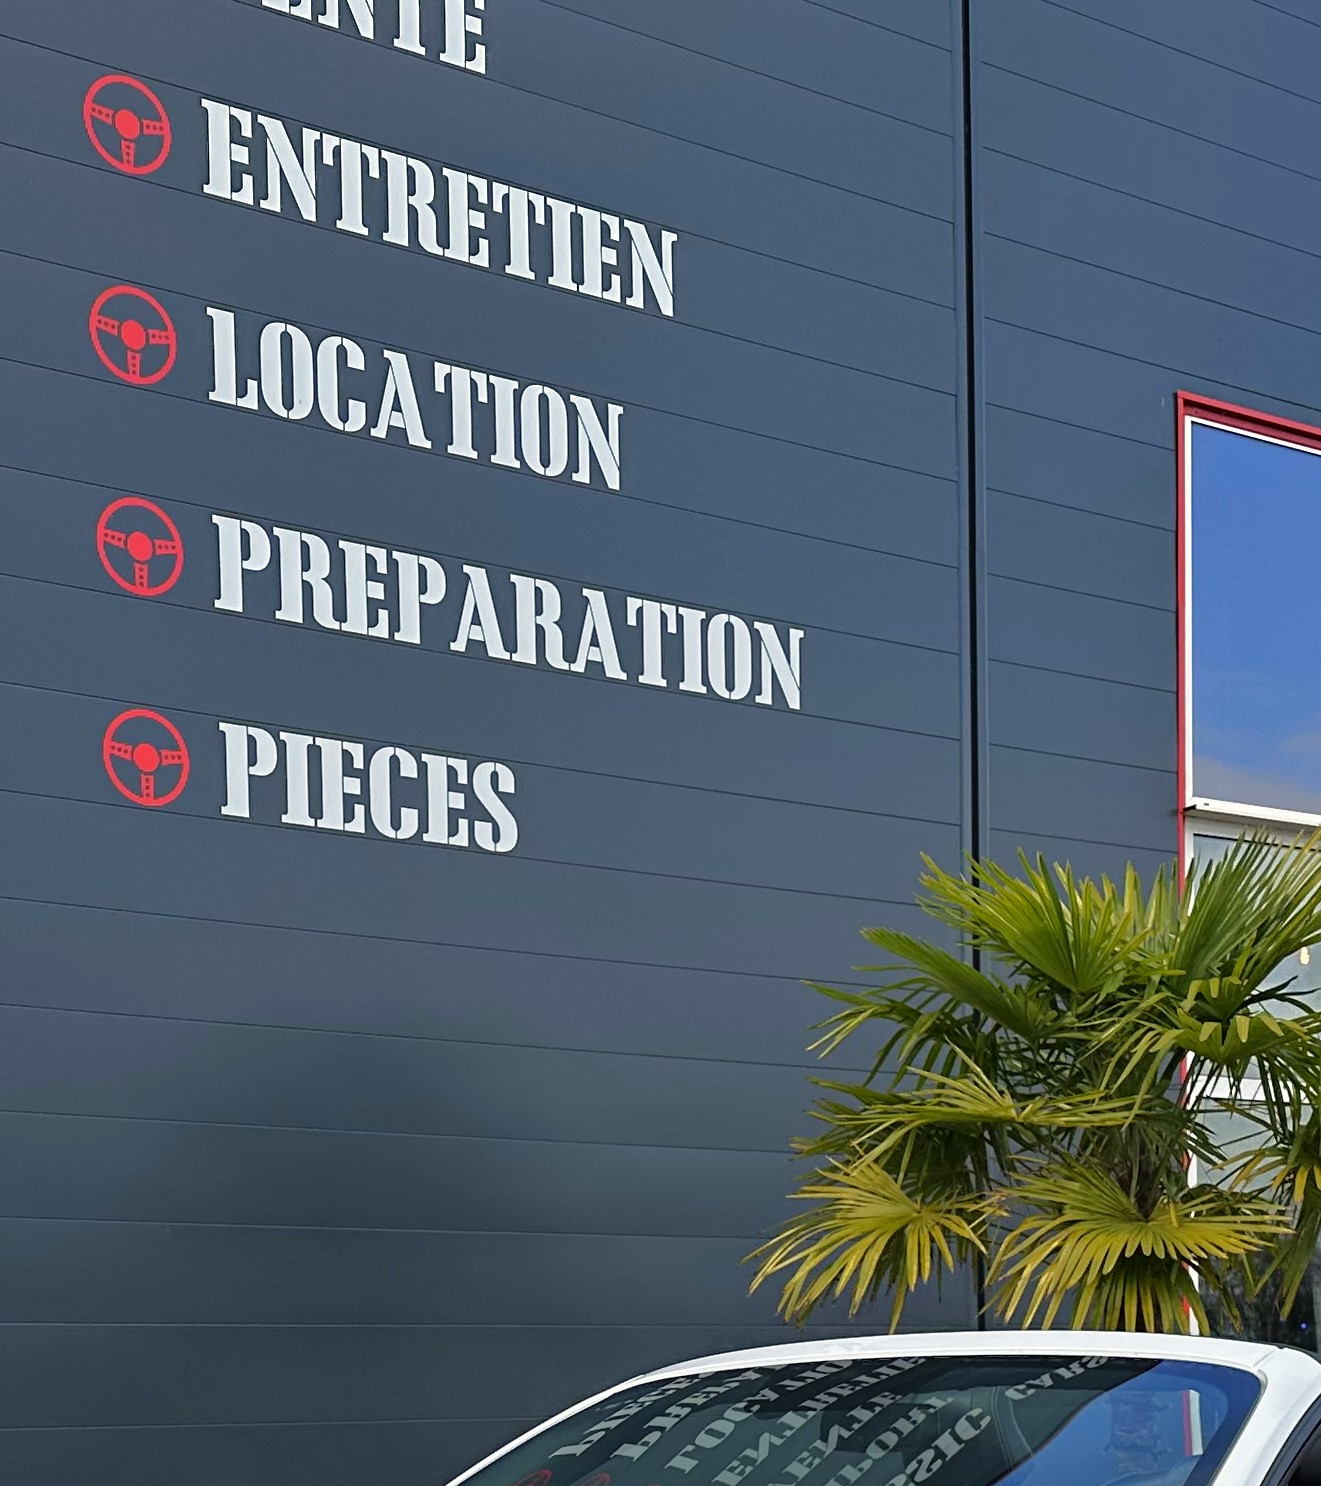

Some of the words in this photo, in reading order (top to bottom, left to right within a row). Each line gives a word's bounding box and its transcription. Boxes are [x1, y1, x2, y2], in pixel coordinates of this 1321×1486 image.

[201, 97, 679, 318] ENTRETIEN
[206, 306, 624, 491] LOCATION
[212, 514, 805, 710] PREPARATION
[218, 721, 519, 853] PIECES
